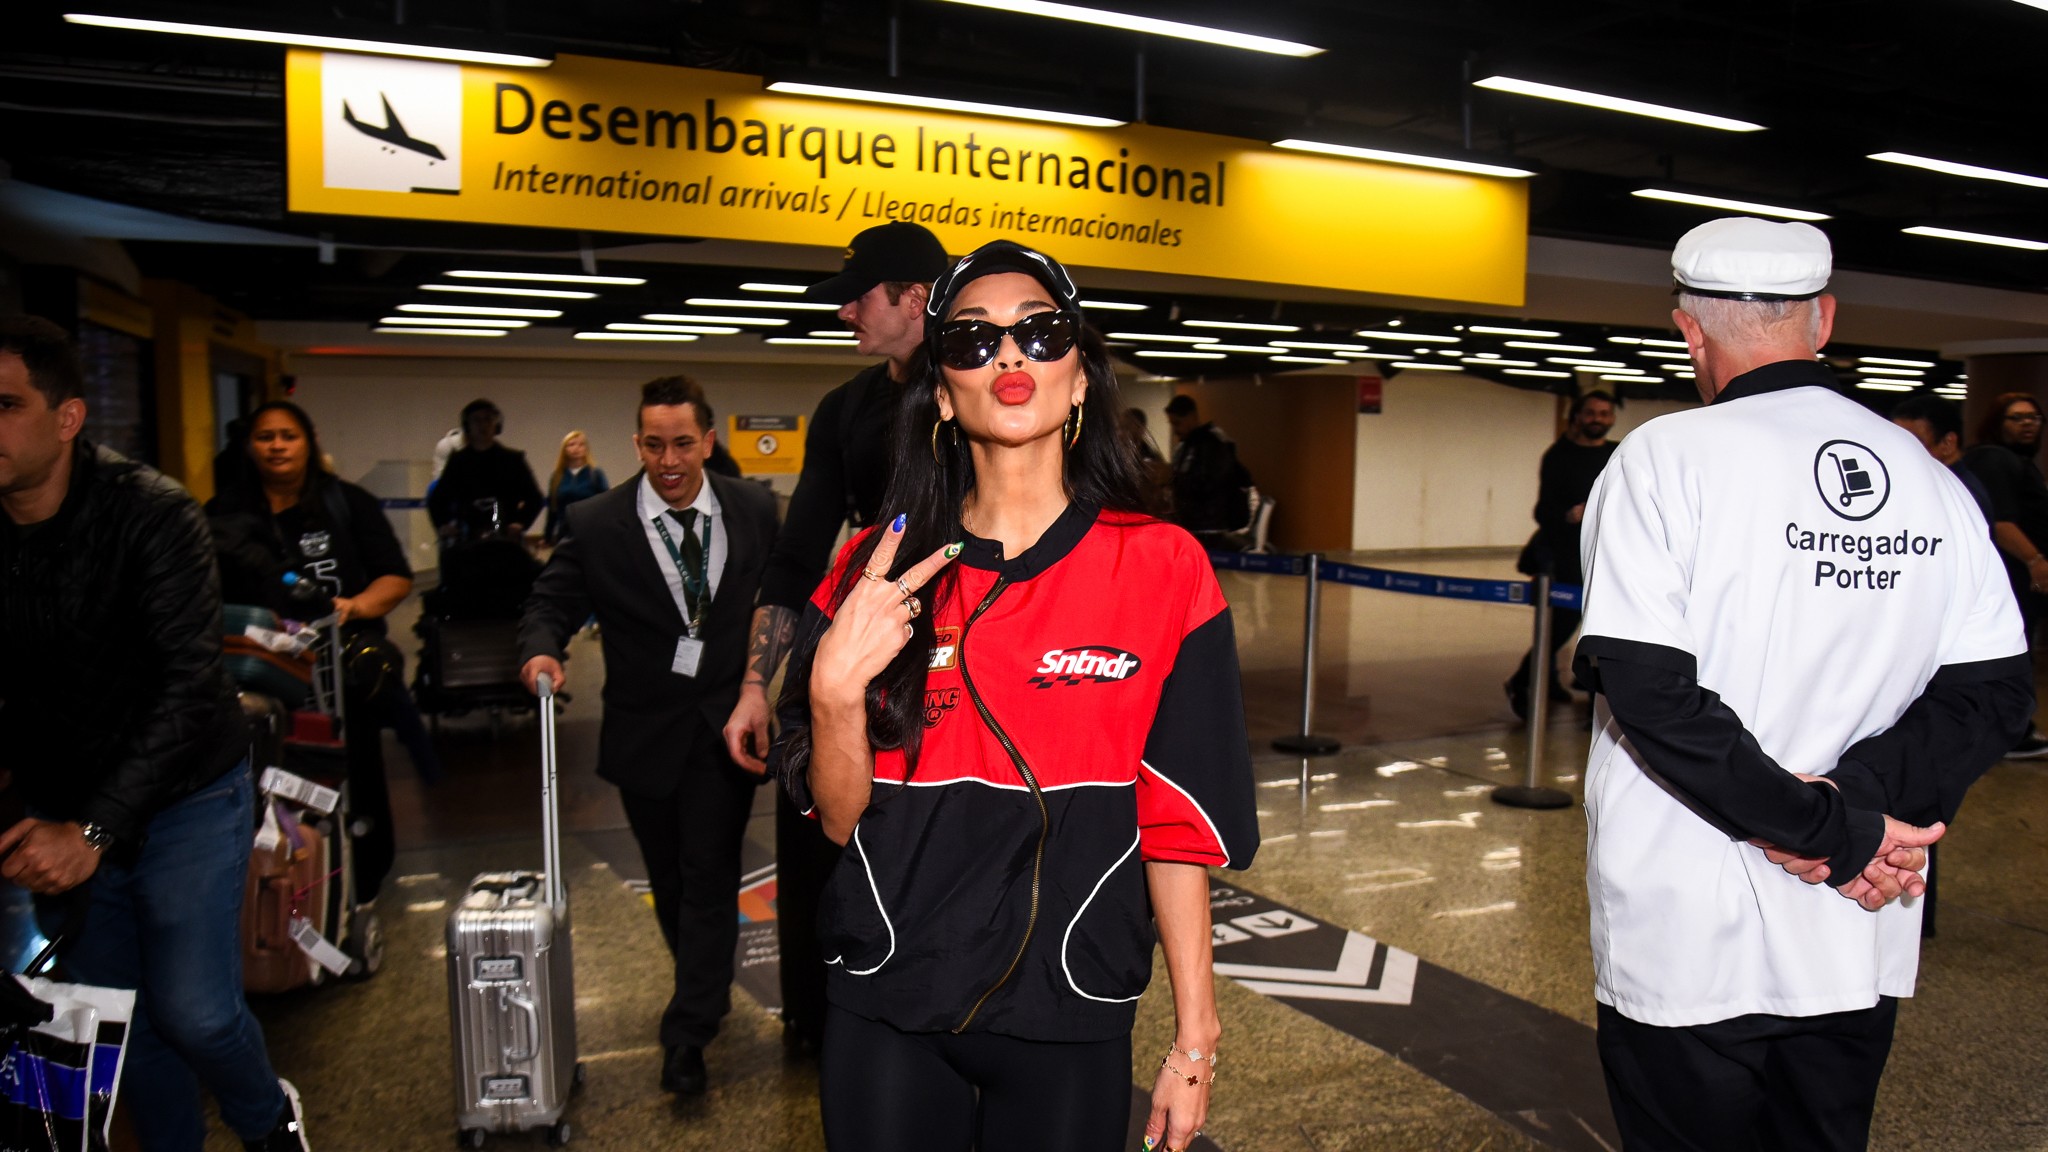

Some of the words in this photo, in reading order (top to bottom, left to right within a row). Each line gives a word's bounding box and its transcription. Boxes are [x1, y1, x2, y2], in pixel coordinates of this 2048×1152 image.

[493, 82, 896, 178] Desembarque
[916, 126, 1225, 207] Internacional
[492, 161, 713, 205] International
[719, 182, 831, 214] arrivals
[835, 187, 857, 221] /
[862, 191, 982, 226] Llegadas
[989, 203, 1183, 247] internacionales
[1785, 522, 1943, 562] Carregador
[1814, 561, 1901, 590] Porter
[1036, 649, 1139, 680] Sntndr
